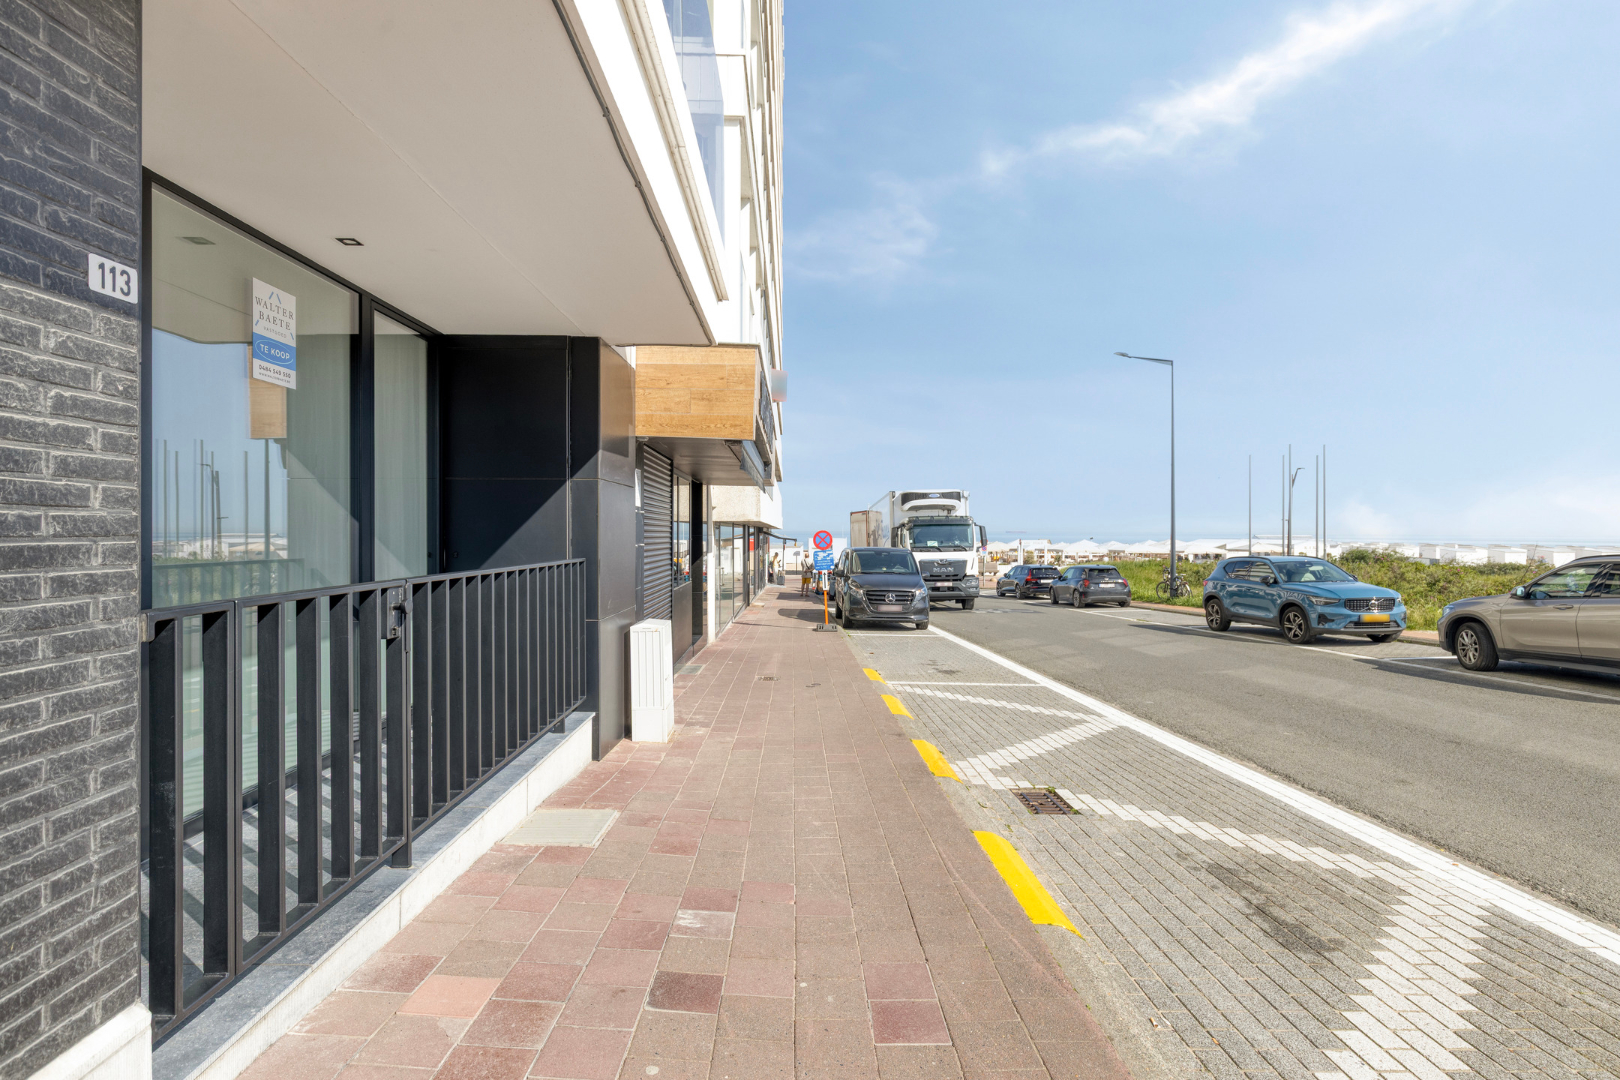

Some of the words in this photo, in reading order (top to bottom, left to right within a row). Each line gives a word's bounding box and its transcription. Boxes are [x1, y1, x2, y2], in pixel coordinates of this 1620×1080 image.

[98, 262, 131, 297] 113
[255, 296, 294, 320] WALTER
[259, 310, 291, 331] BAETE
[259, 343, 269, 354] TE
[270, 347, 290, 360] KOOP
[258, 364, 272, 373] 0484
